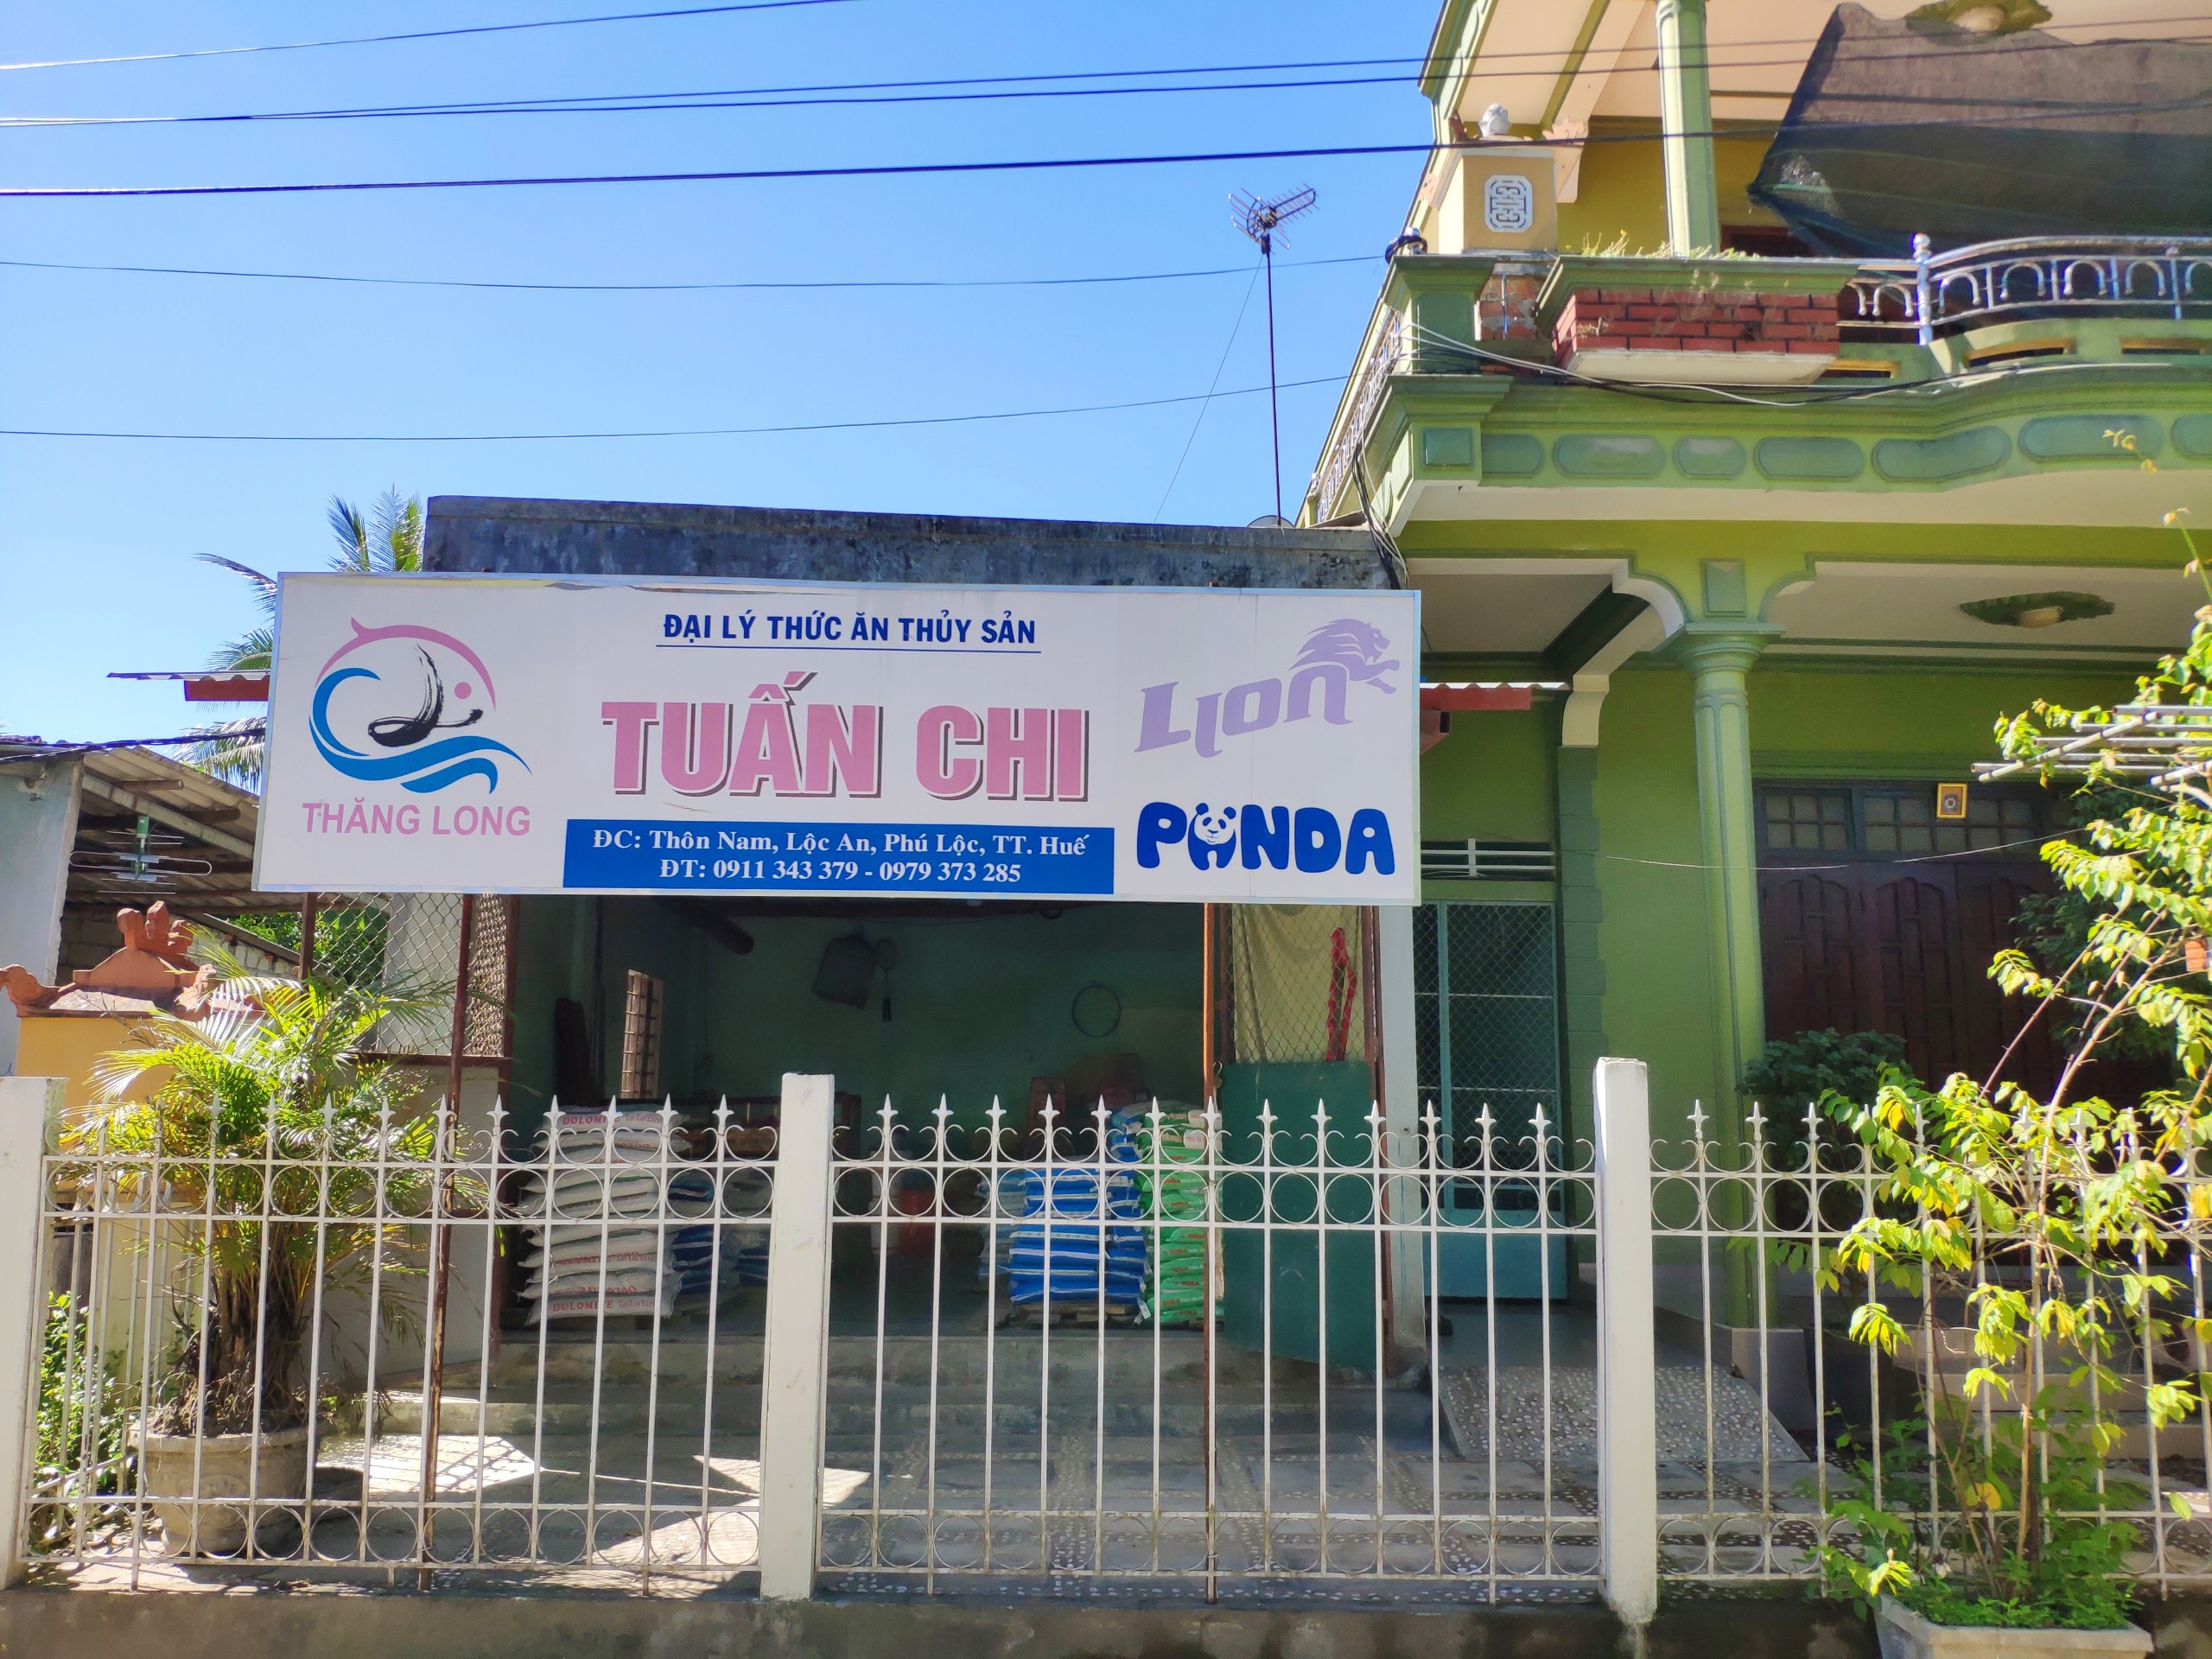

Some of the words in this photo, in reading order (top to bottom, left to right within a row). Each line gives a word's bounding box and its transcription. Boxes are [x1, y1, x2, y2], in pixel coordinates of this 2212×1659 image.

[663, 613, 711, 644] ĐẠI
[721, 609, 756, 639] LÝ
[766, 609, 842, 640] THỨC
[850, 612, 889, 641] ĂN
[898, 609, 972, 643] THỦY
[981, 609, 1035, 644] SẢN
[601, 671, 884, 799] TUẤN
[915, 705, 1090, 803] CHI
[302, 797, 421, 836] THĂNG
[433, 804, 531, 836] LONG
[593, 830, 641, 849] ĐC:
[649, 830, 709, 849] Thôn
[717, 831, 779, 854] Nam,
[785, 832, 830, 855] Lộc
[836, 833, 877, 855] An,
[884, 833, 928, 853] Phú
[936, 834, 986, 856] Lộc,
[992, 835, 1033, 855] TT.
[1039, 834, 1090, 855] Huế
[1136, 801, 1396, 876] PANDA
[660, 859, 706, 878] ĐT:
[713, 860, 764, 879] 0911
[772, 860, 812, 880] 343
[817, 861, 858, 880] 379
[879, 861, 931, 880] 0979
[937, 861, 976, 881] 373
[982, 862, 1021, 883] 285
[552, 1300, 613, 1312] DOLOMIE
